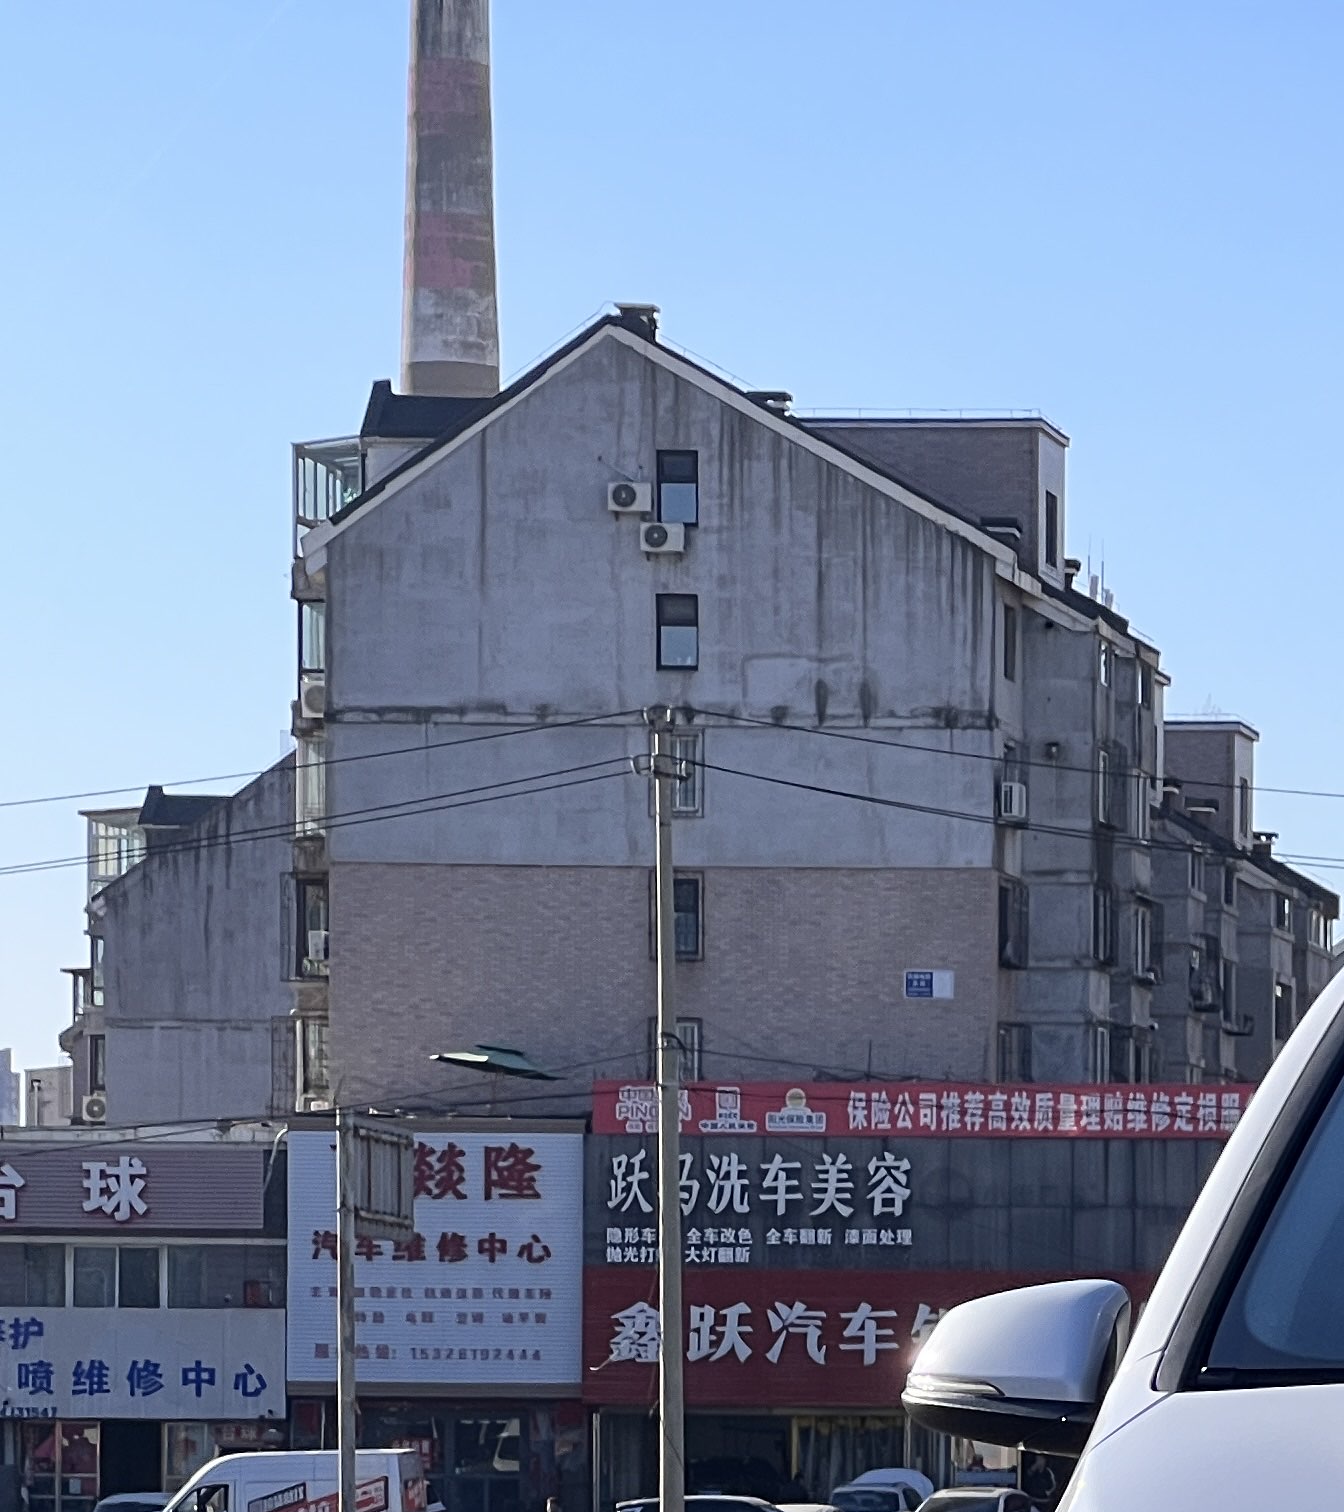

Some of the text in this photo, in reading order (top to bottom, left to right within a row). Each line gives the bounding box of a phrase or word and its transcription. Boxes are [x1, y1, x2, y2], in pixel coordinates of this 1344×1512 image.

[847, 1090, 1249, 1132] 保险公司推荐高效质量理赔维修定损服
[606, 1149, 912, 1218] 跃马洗车美容
[312, 1230, 551, 1263] 汽车维修中心
[606, 1227, 658, 1245] 隐形车
[686, 1227, 753, 1245] 全车改色
[765, 1228, 833, 1245] 全车翻新
[606, 1246, 751, 1263] 抛光打 大灯翻新
[0, 1317, 44, 1350] 护
[609, 1300, 946, 1366] 鑫跃汽车
[18, 1359, 267, 1398] 喷维修中心
